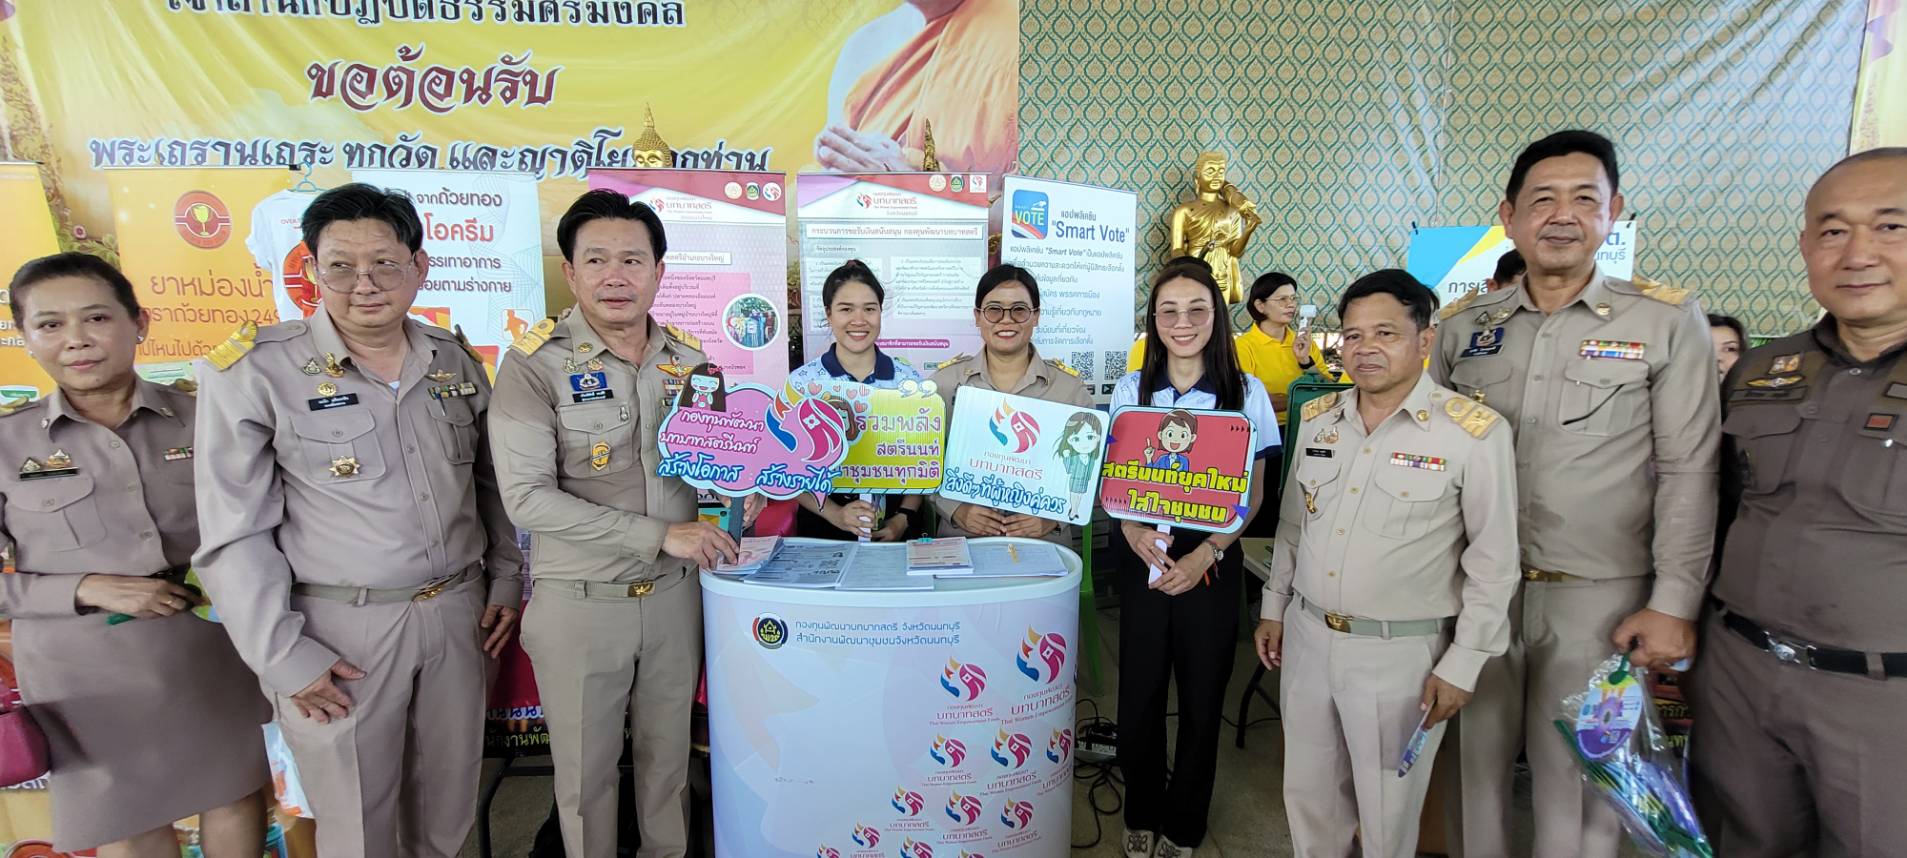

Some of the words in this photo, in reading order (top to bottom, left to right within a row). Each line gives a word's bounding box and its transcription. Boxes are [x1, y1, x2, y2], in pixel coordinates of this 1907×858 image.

[307, 44, 559, 112] ขอต้อนรับ
[416, 187, 503, 207] จากถ้วยทอง
[424, 213, 494, 241] โอครีม
[1015, 210, 1045, 226] VOTE
[1052, 221, 1096, 240] "Smart
[1099, 225, 1130, 243] Vote"
[428, 256, 501, 269] รรเทาอาการ
[681, 410, 764, 431] กองทุนพัฒนา
[855, 407, 941, 432] รวมพลัง
[660, 432, 762, 453] บทบาทสตรีนนท์
[876, 438, 940, 457] สตรีนนท์
[657, 452, 745, 482] สร้างโอกาส
[756, 462, 841, 494] สร้างรายได้
[839, 460, 940, 484] าชุมชนทุกมิติ
[969, 457, 1045, 481] บทบาทสตรี
[1101, 459, 1249, 493] สตรีนนท์ยุคใหม่
[1127, 488, 1228, 523] ใส่ใจชุมชน
[795, 620, 898, 632] กองทุนพัฒนาบทบาทสตรี
[902, 620, 961, 632] จังหวัดนนทบุรี
[796, 633, 961, 647] สำนักงานพัฒนาชุมชนจังหวัดนนทบุรี
[1011, 685, 1071, 716] บทบาทสตรี
[937, 707, 994, 720] บทบาทสตรี
